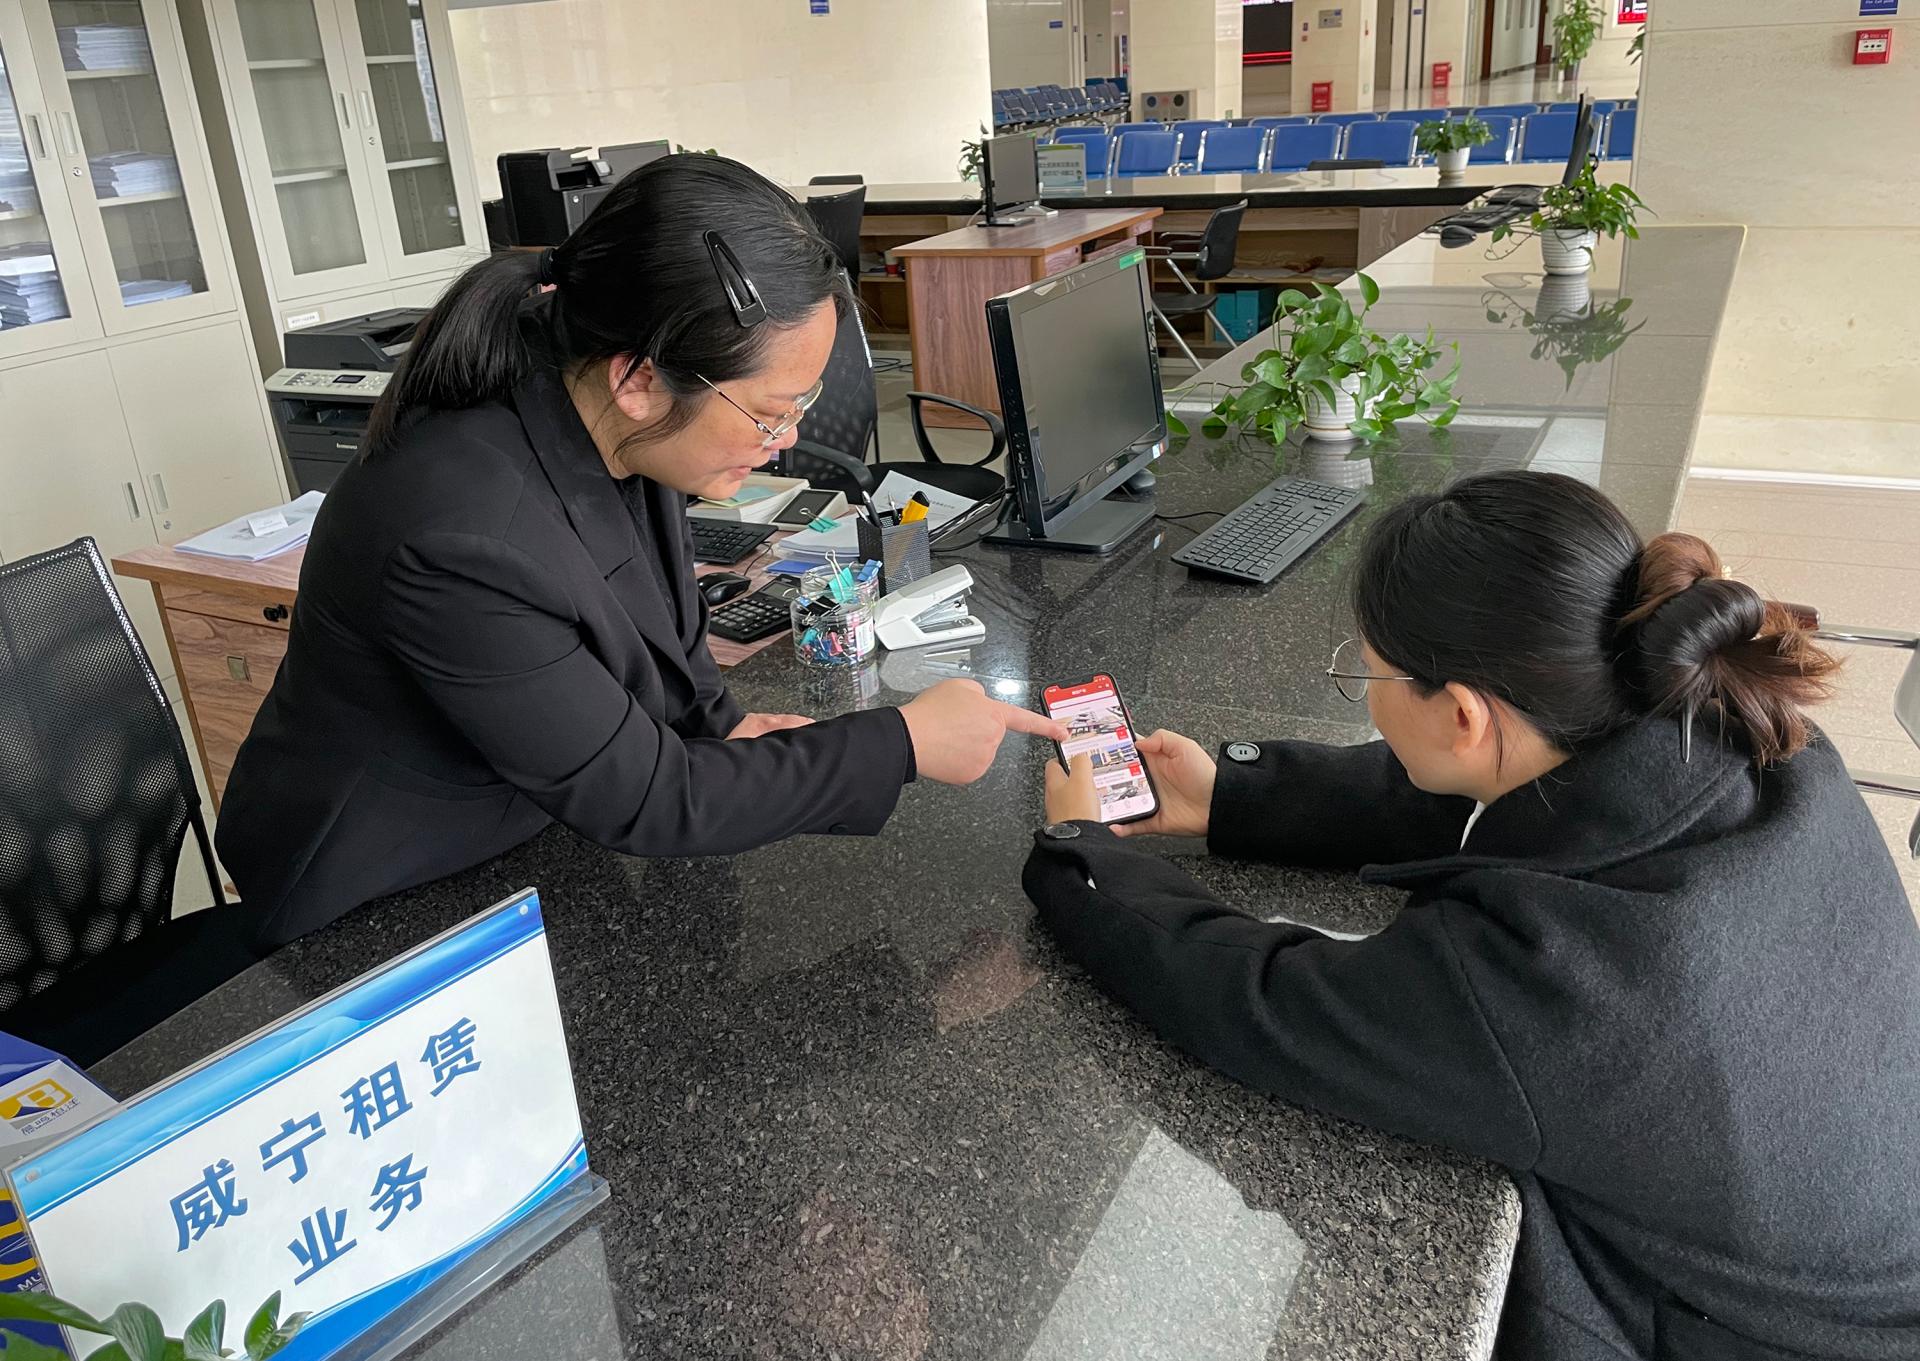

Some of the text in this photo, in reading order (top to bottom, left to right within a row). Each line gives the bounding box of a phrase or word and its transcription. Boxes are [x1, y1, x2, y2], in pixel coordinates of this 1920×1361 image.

[169, 1016, 482, 1252] 威宁租赁
[287, 1152, 429, 1286] 业务
